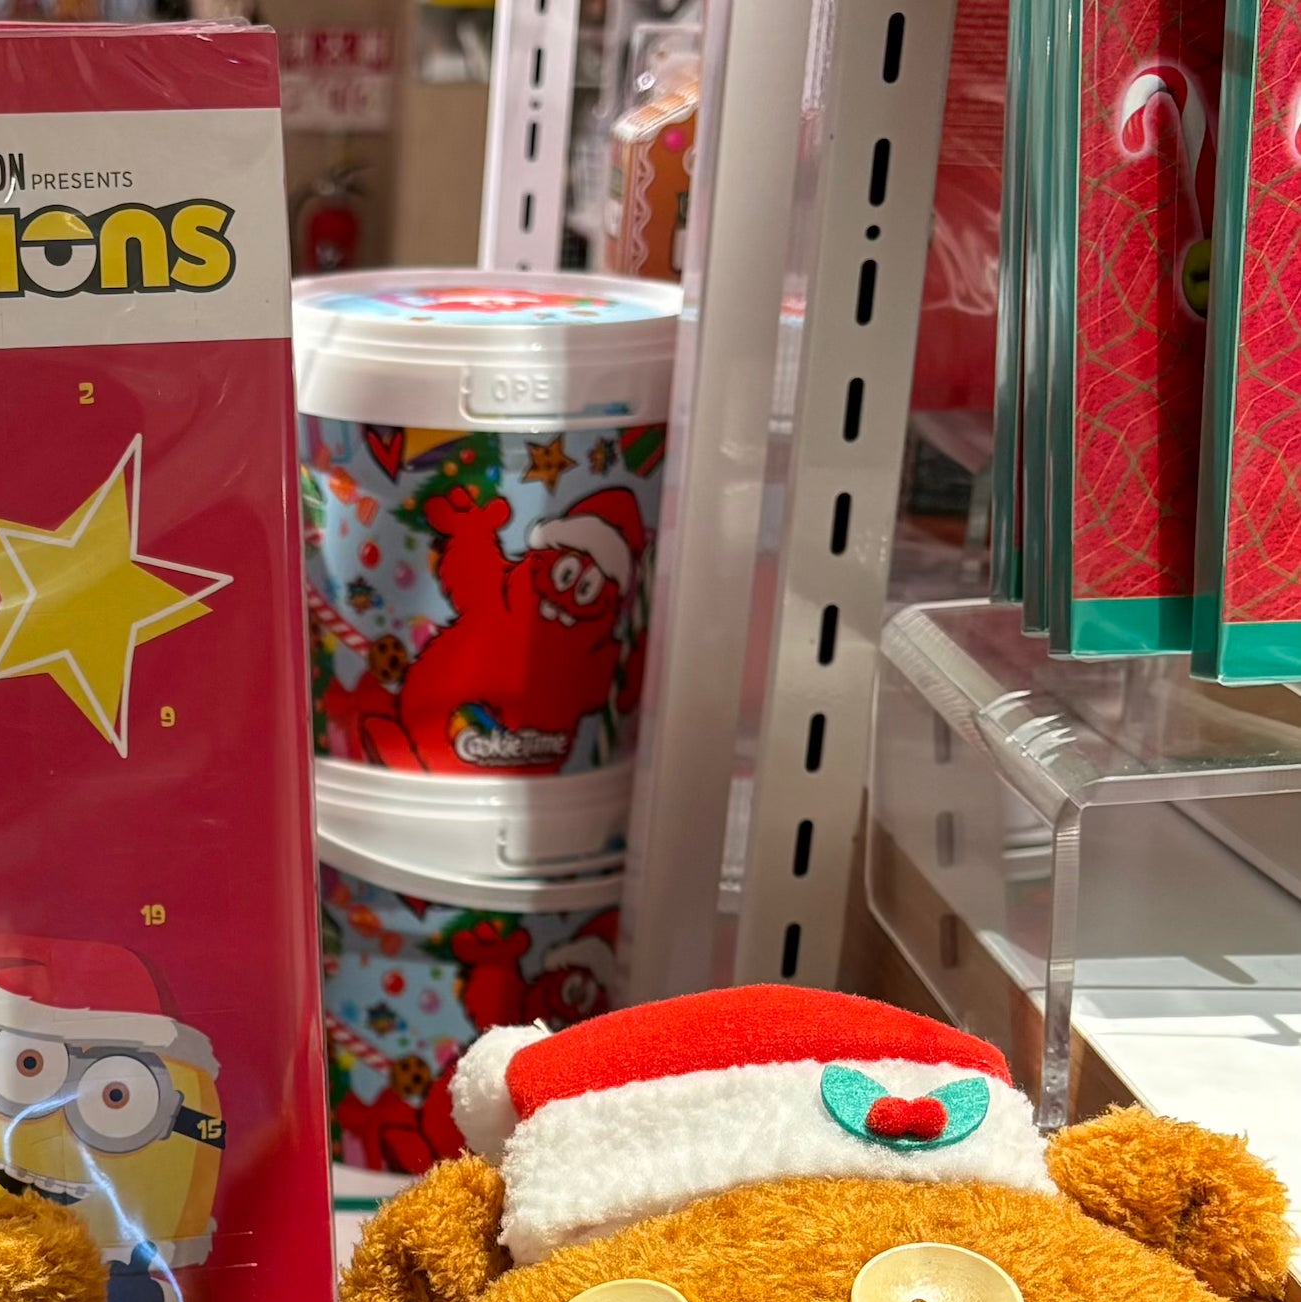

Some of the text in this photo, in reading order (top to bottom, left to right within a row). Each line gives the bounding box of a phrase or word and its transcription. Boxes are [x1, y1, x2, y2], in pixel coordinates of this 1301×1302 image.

[31, 171, 134, 191] PRESENTS
[79, 382, 95, 404] 2
[159, 705, 176, 727] 9
[140, 903, 166, 926] 19
[196, 1118, 223, 1140] 15
